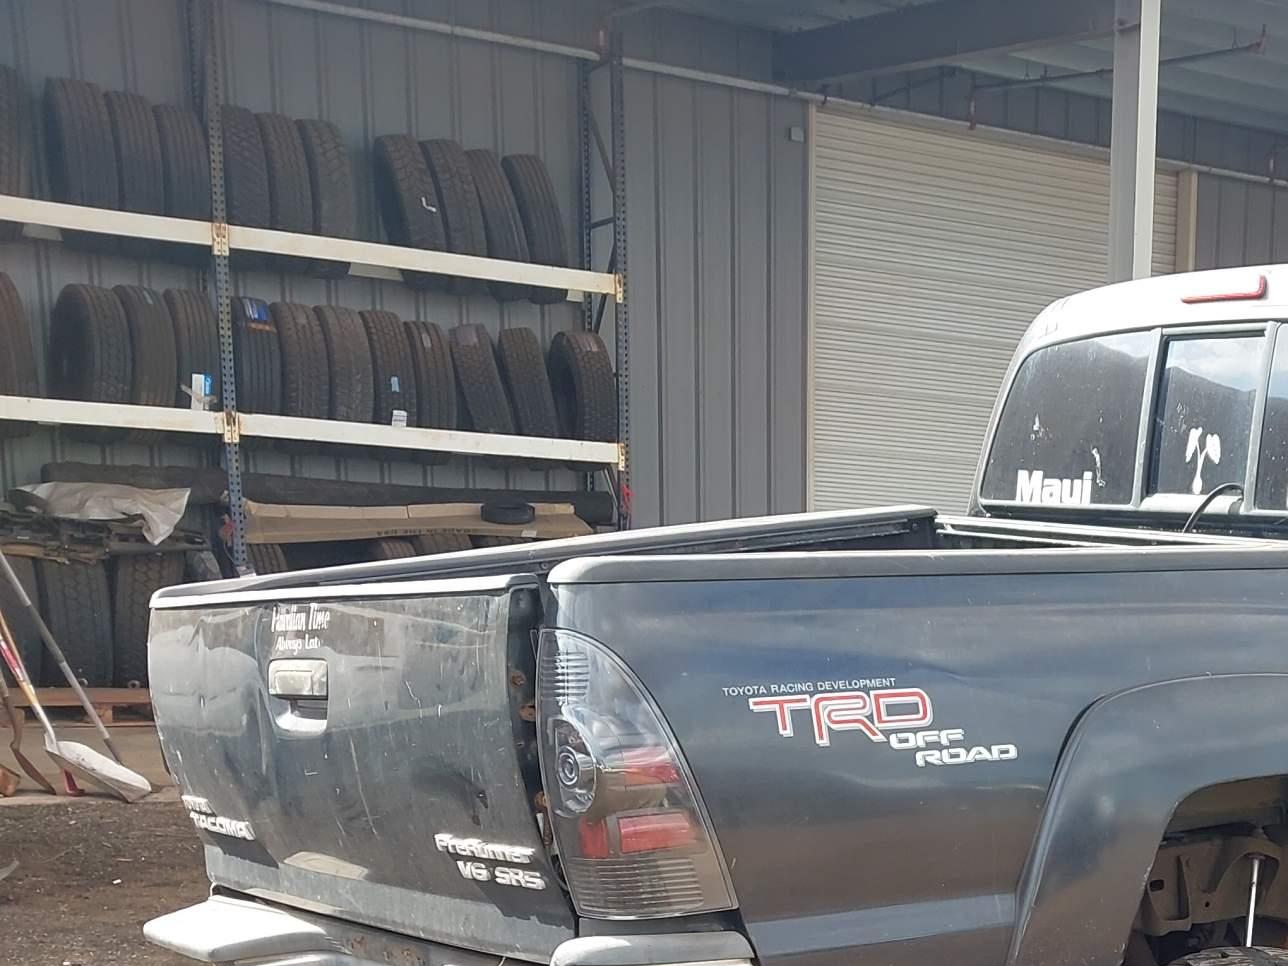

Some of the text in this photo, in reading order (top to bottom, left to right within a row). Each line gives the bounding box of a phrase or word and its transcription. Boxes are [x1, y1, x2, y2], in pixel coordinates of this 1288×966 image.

[1016, 470, 1092, 505] Maui
[308, 603, 330, 630] Time
[722, 678, 897, 697] TOYOTA RACING DEVELOPMENT
[749, 687, 933, 746] TRD
[889, 729, 965, 750] OFF
[915, 744, 1018, 767] ROAD
[189, 810, 257, 841] TACOMA
[434, 833, 536, 864] PreRunner
[456, 861, 491, 881] V6
